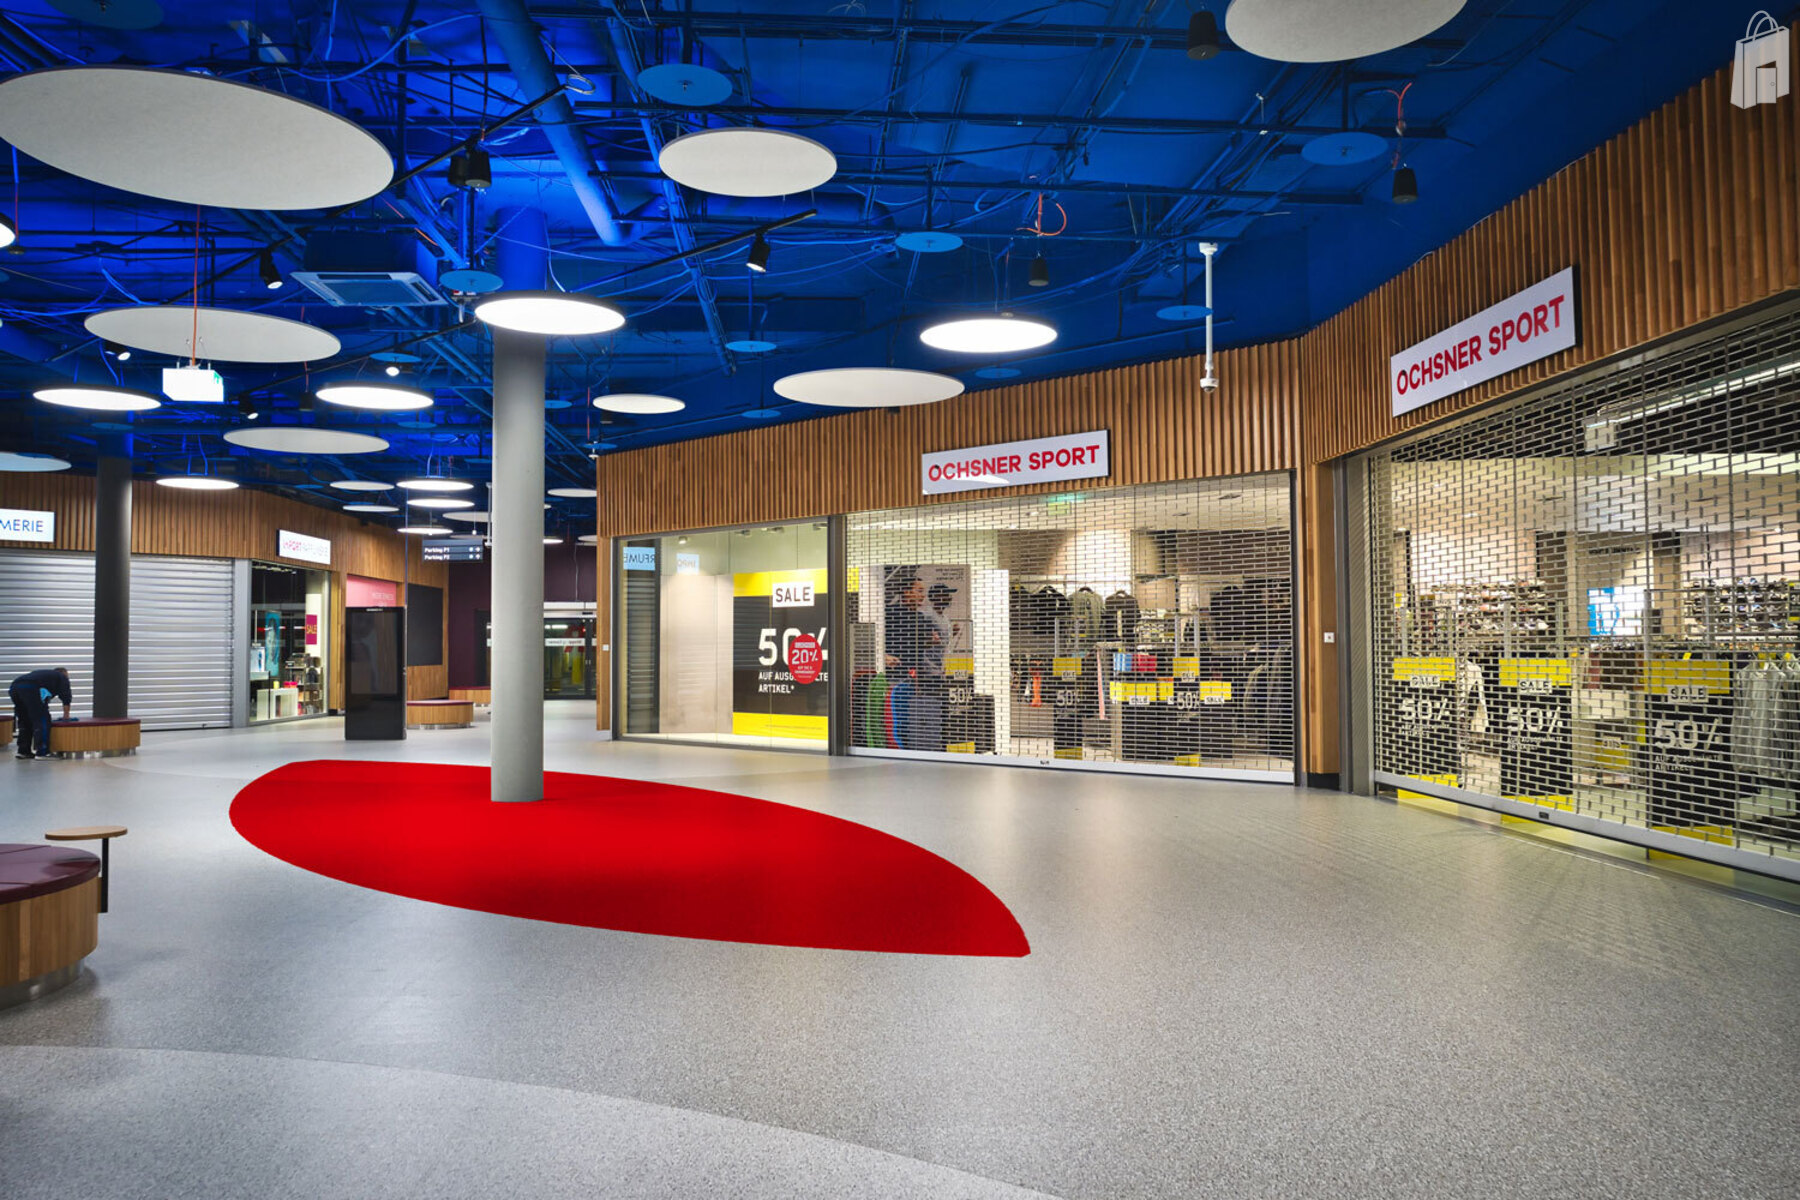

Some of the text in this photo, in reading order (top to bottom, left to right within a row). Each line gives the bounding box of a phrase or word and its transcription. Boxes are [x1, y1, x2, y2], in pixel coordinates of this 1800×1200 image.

[1397, 294, 1564, 395] OCHSNER SPORT
[928, 445, 1100, 482] OCHSNER SPORT
[775, 587, 811, 602] SALE
[306, 624, 318, 634] SALE
[791, 649, 818, 665] 20%
[758, 671, 773, 681] AUF
[1520, 681, 1550, 691] SALE
[1670, 687, 1706, 700] SALE
[1402, 698, 1450, 720] 50%
[1507, 706, 1564, 734] 50%
[1654, 719, 1720, 749] 50%
